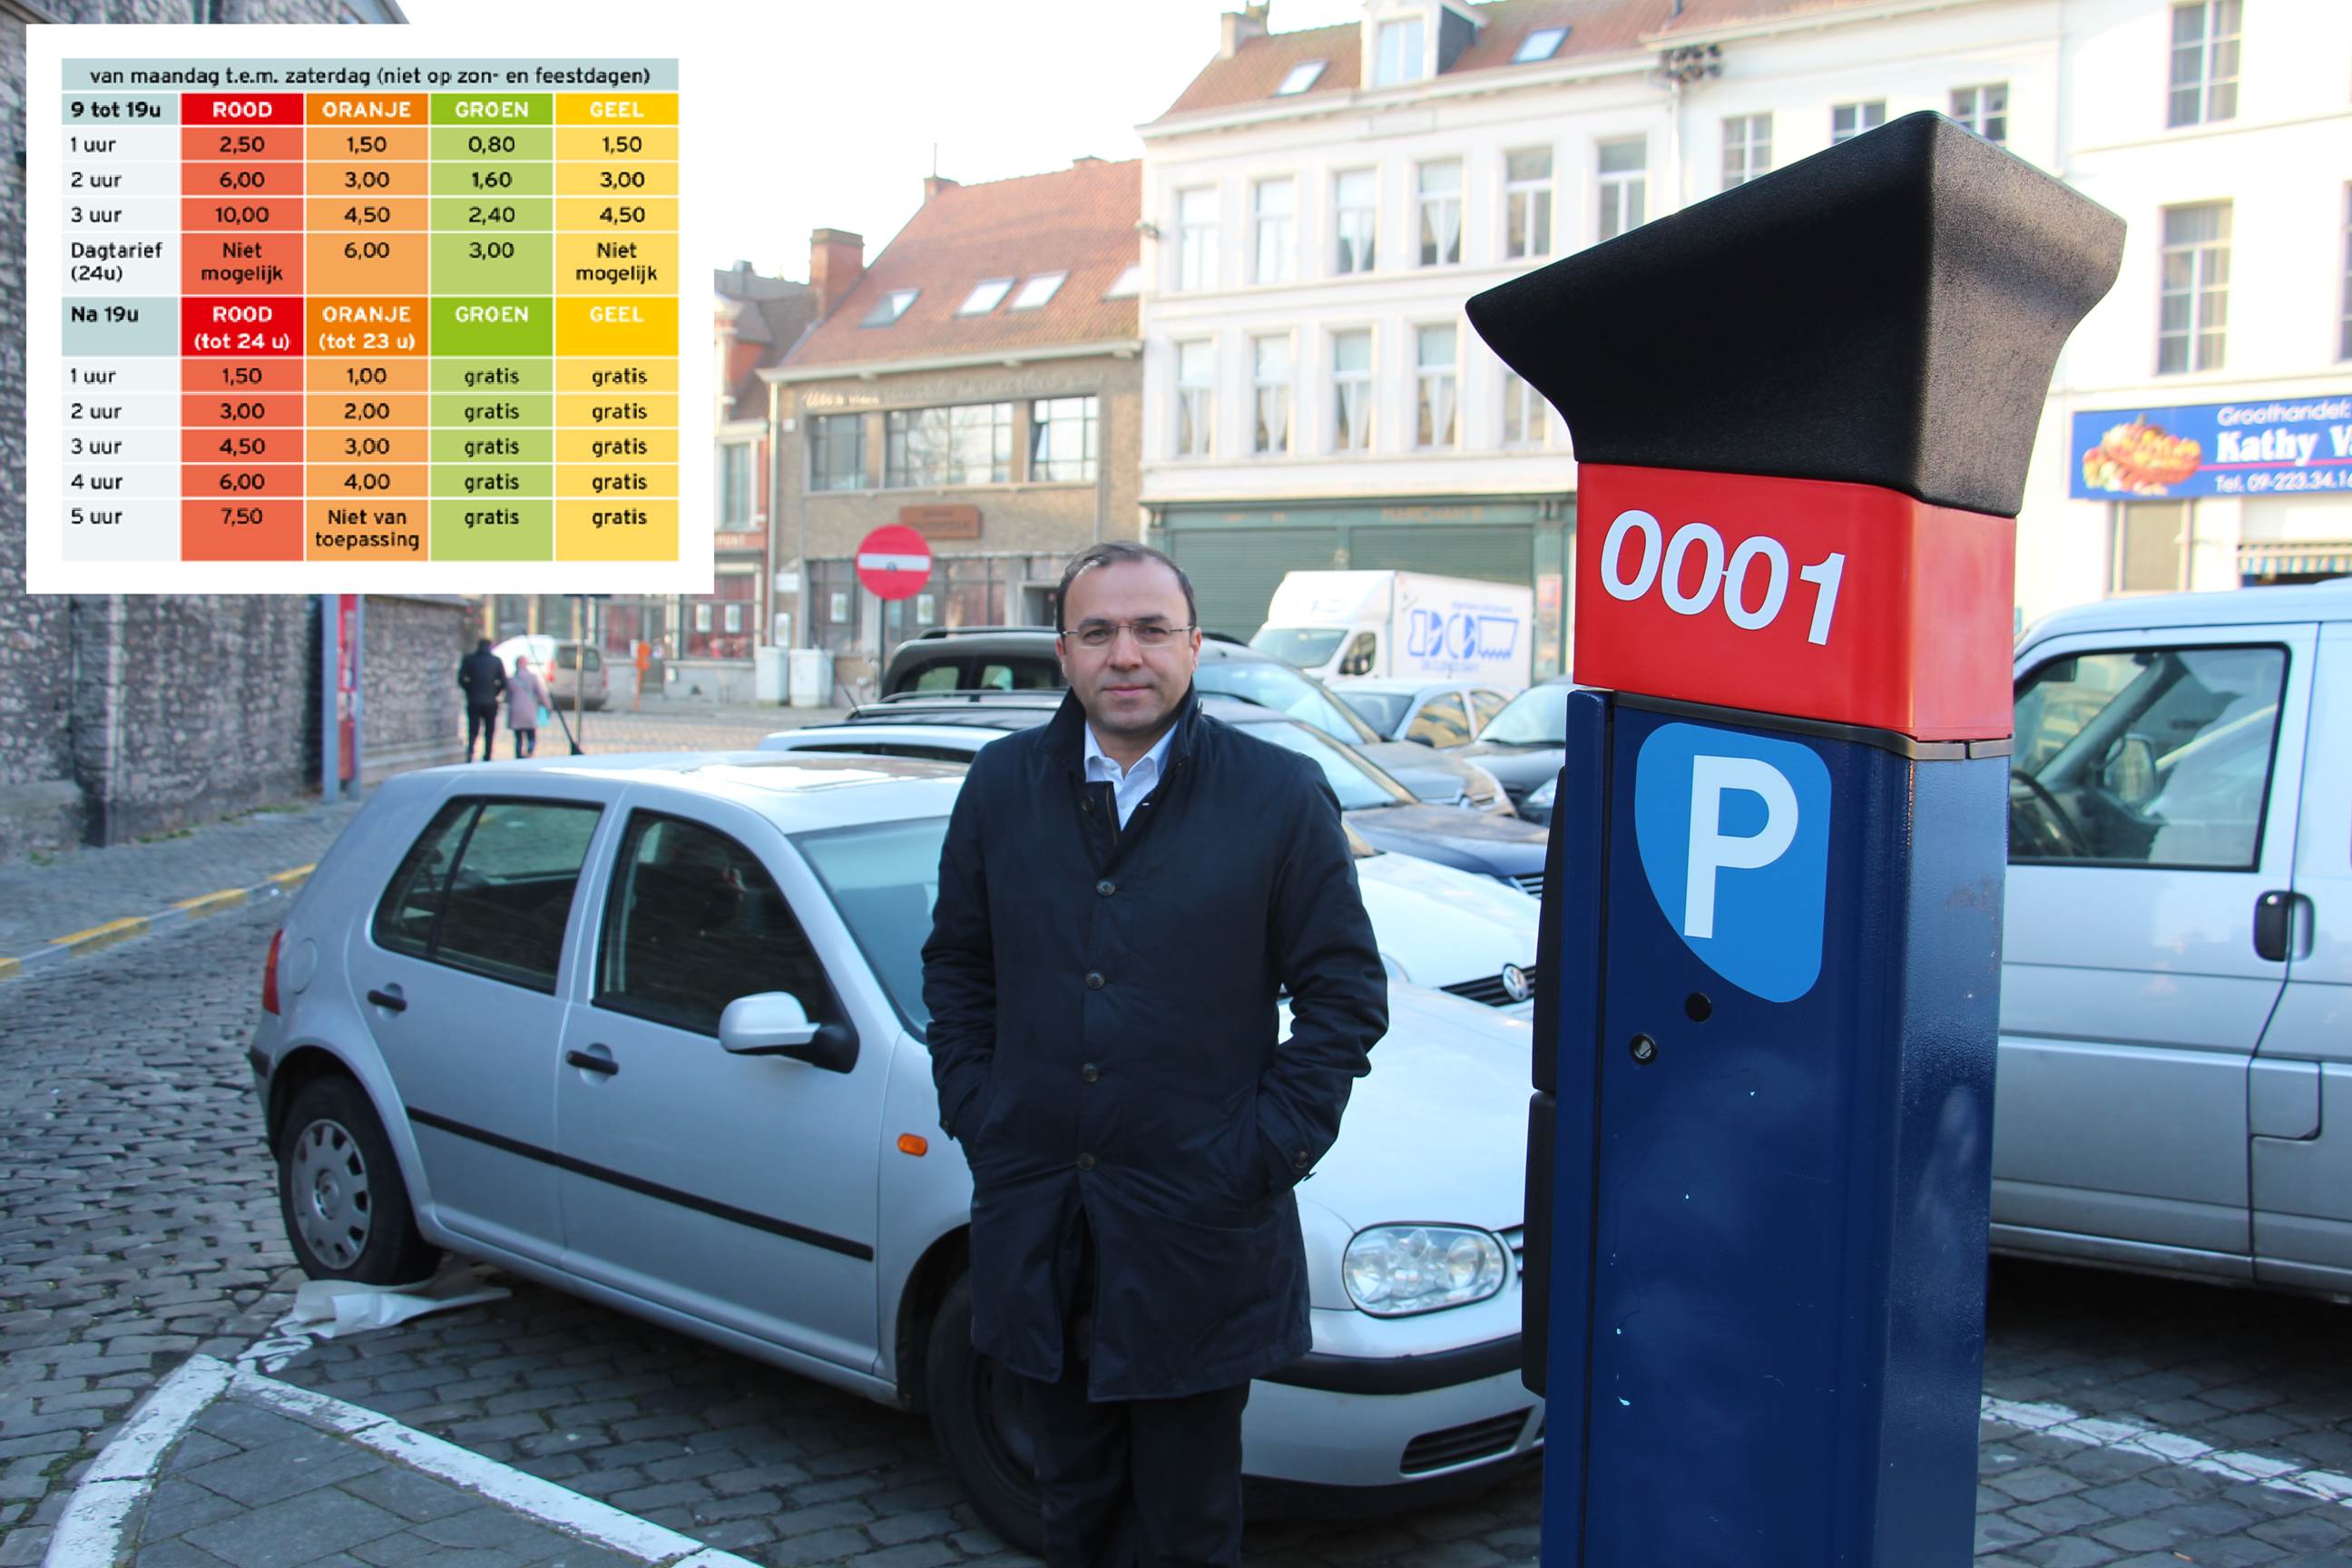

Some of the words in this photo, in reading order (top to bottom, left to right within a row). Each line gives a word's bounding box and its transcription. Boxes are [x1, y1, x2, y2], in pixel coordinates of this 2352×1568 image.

[2216, 428, 2318, 466] Kathy
[1601, 509, 1846, 646] 0001
[1684, 755, 1798, 939] P
